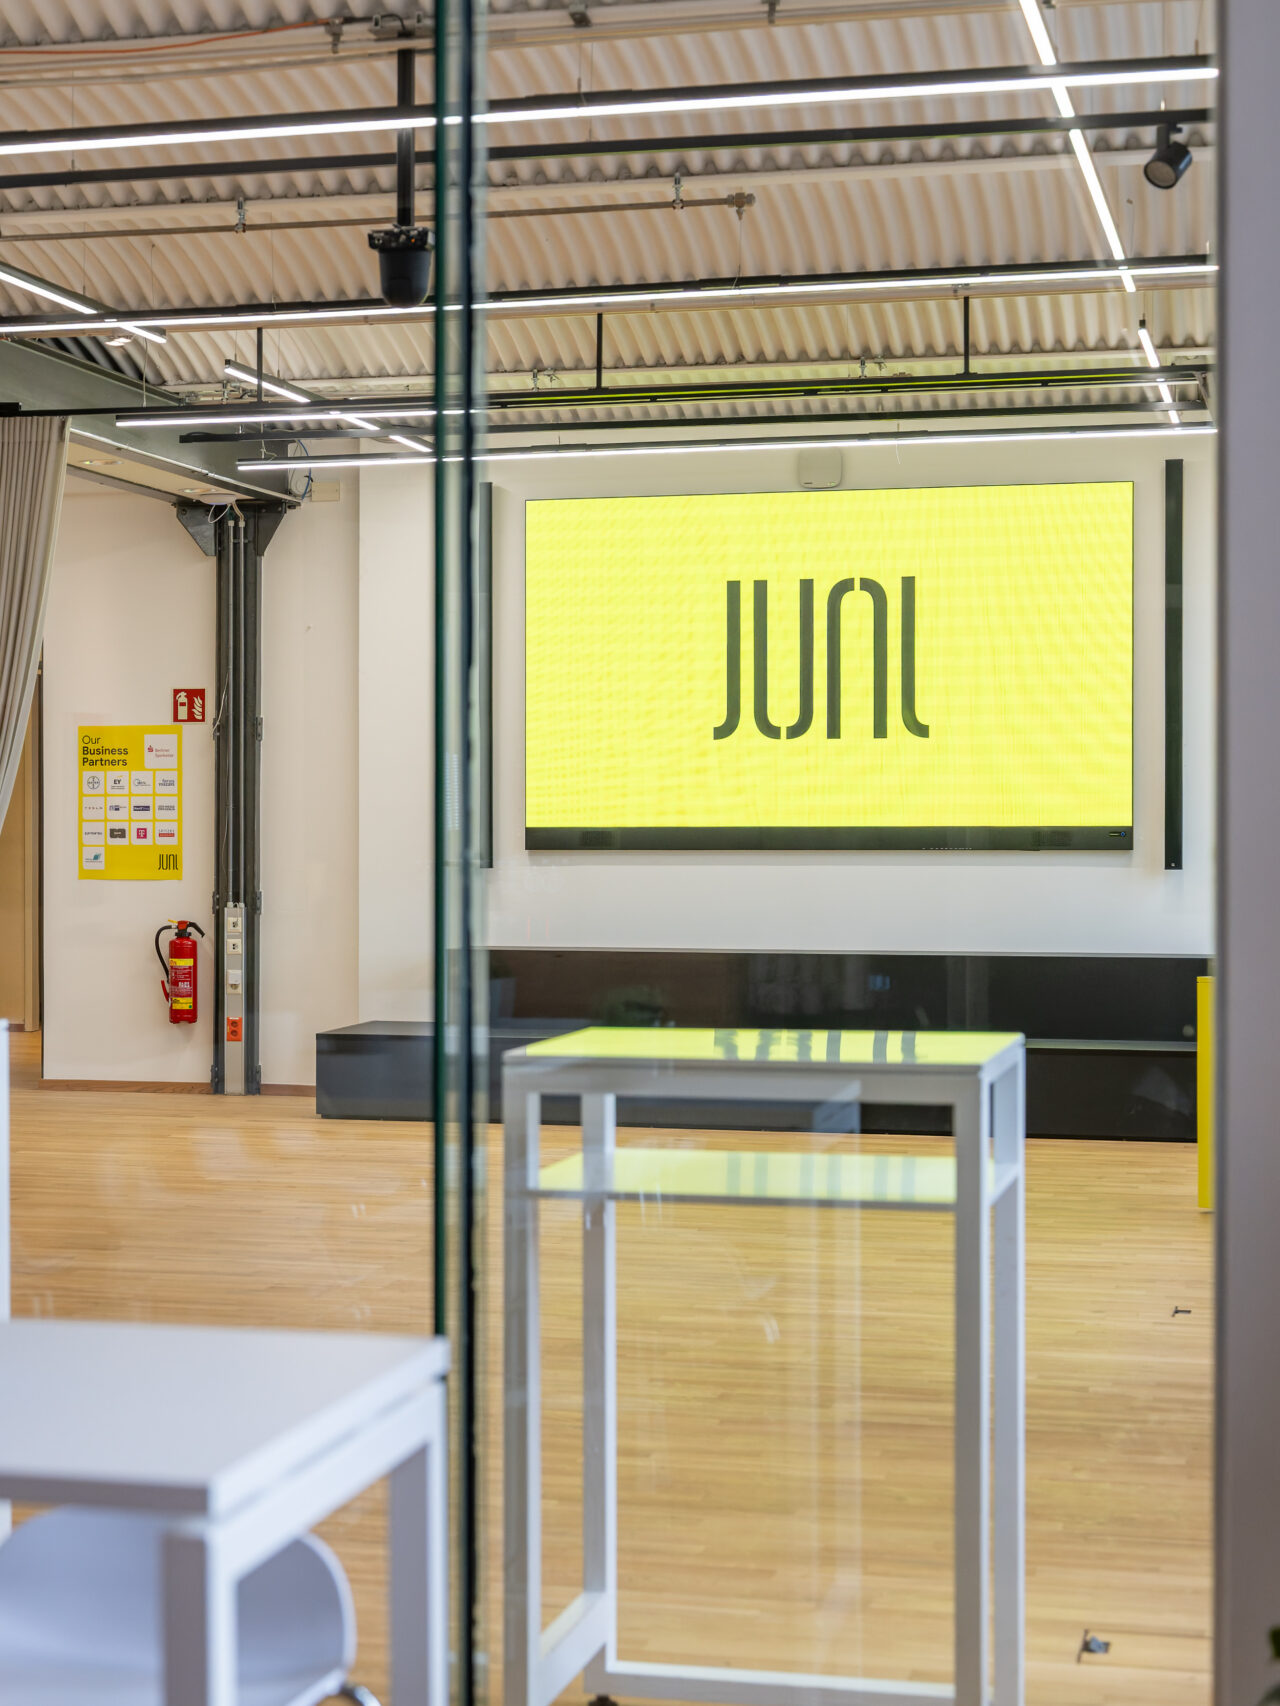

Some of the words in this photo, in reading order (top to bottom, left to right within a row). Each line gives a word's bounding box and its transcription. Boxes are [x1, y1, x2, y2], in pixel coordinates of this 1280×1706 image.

[81, 735, 101, 745] Our
[82, 746, 129, 756] Business
[82, 757, 128, 767] Partners
